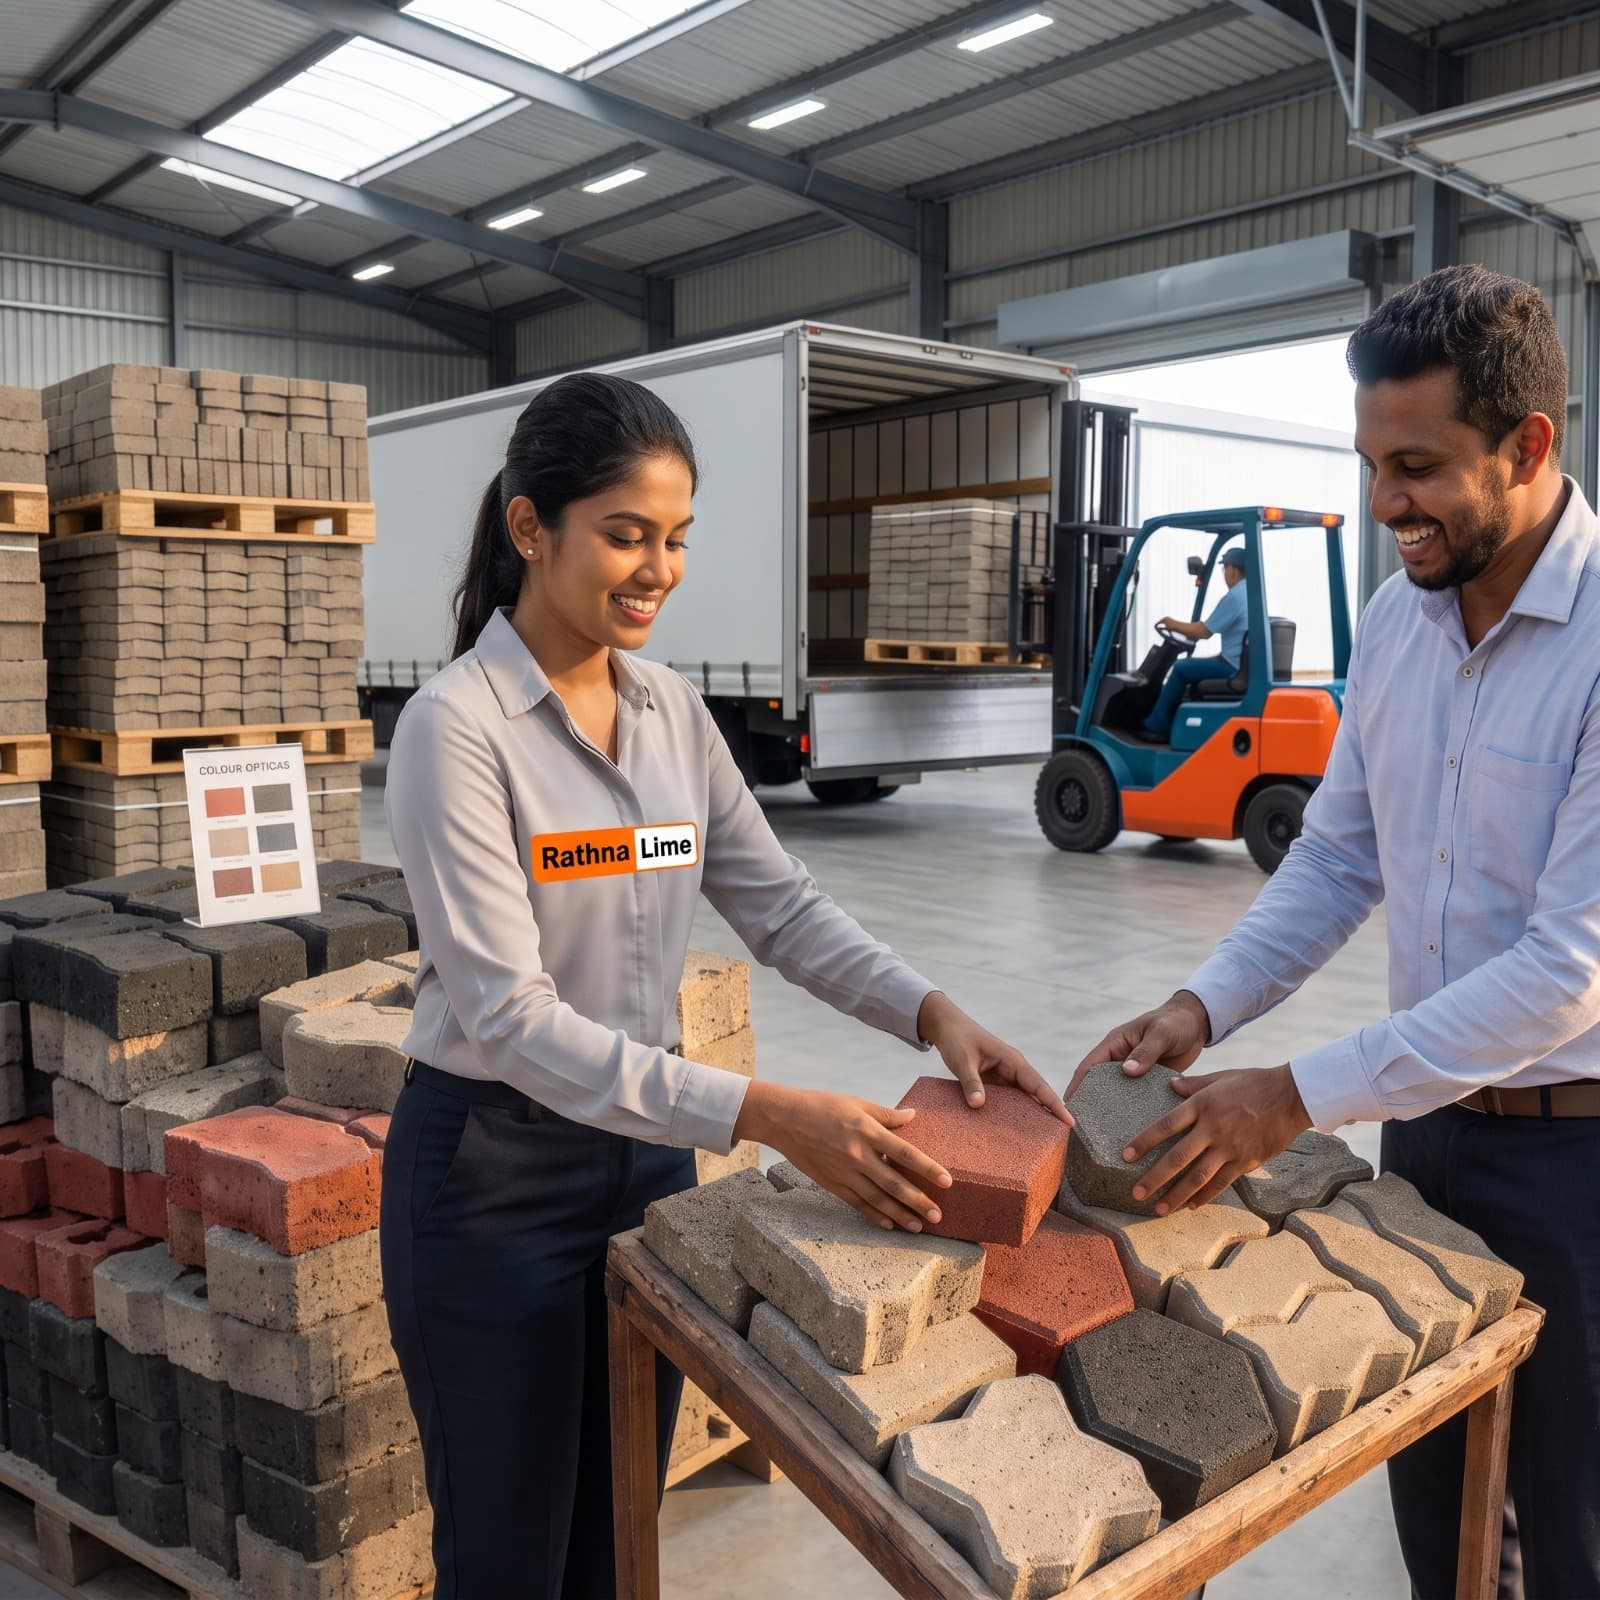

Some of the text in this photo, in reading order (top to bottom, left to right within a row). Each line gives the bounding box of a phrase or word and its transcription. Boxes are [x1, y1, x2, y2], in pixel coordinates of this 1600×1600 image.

[199, 761, 290, 776] COLOUR OPTICAS
[541, 836, 692, 870] Rathna Lime
